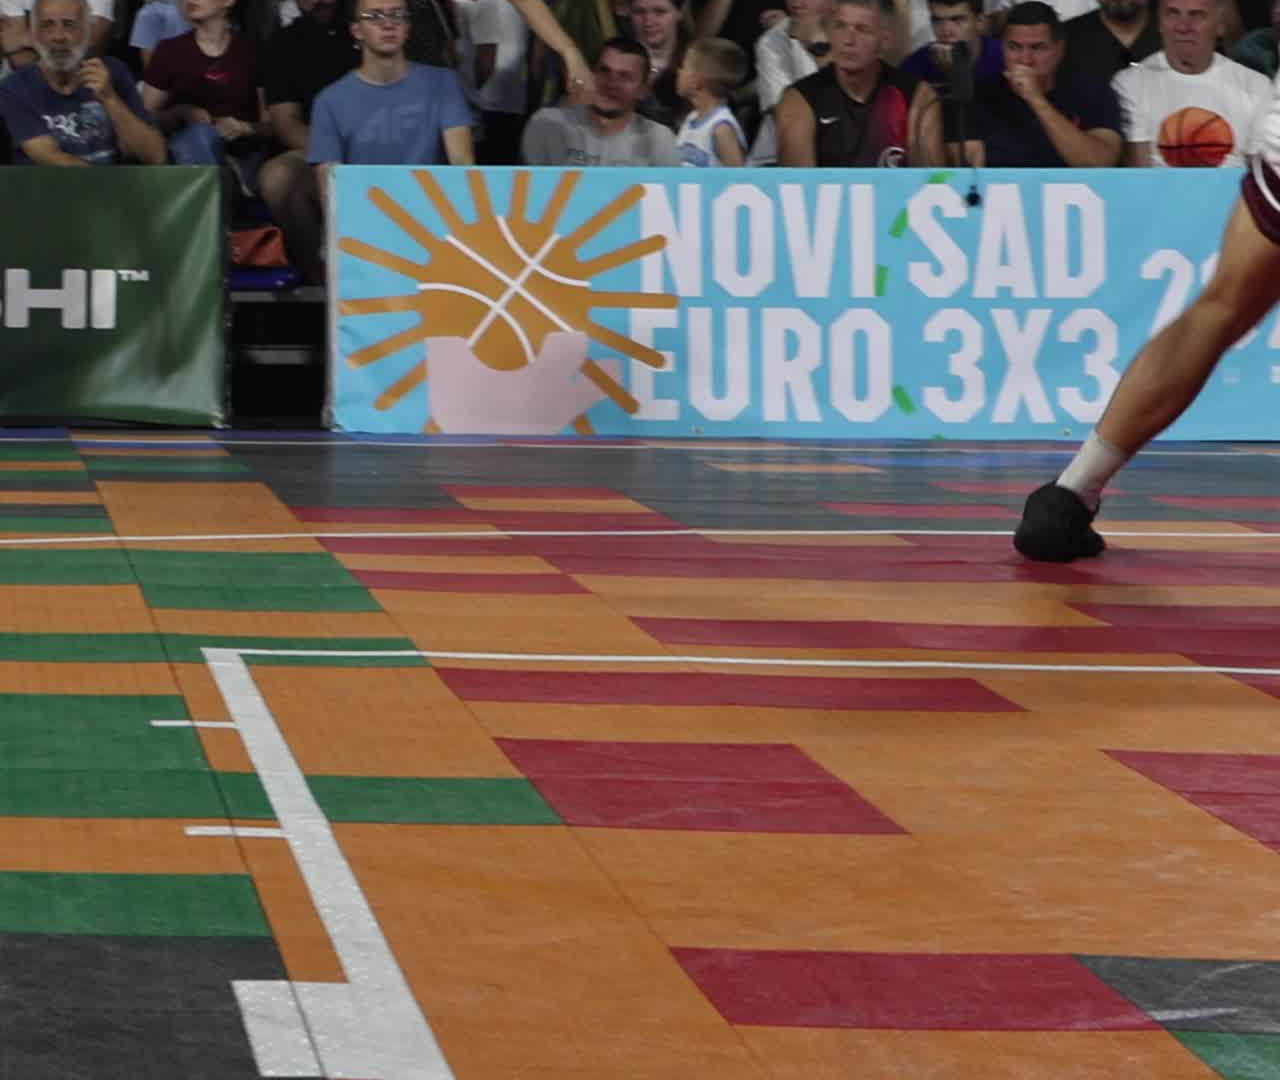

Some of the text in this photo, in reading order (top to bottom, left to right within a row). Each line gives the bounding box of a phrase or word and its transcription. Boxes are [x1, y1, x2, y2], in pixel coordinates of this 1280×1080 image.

[640, 182, 877, 299] NOVI
[906, 182, 1108, 300] SAD
[630, 306, 1122, 424] EURO 3X3
